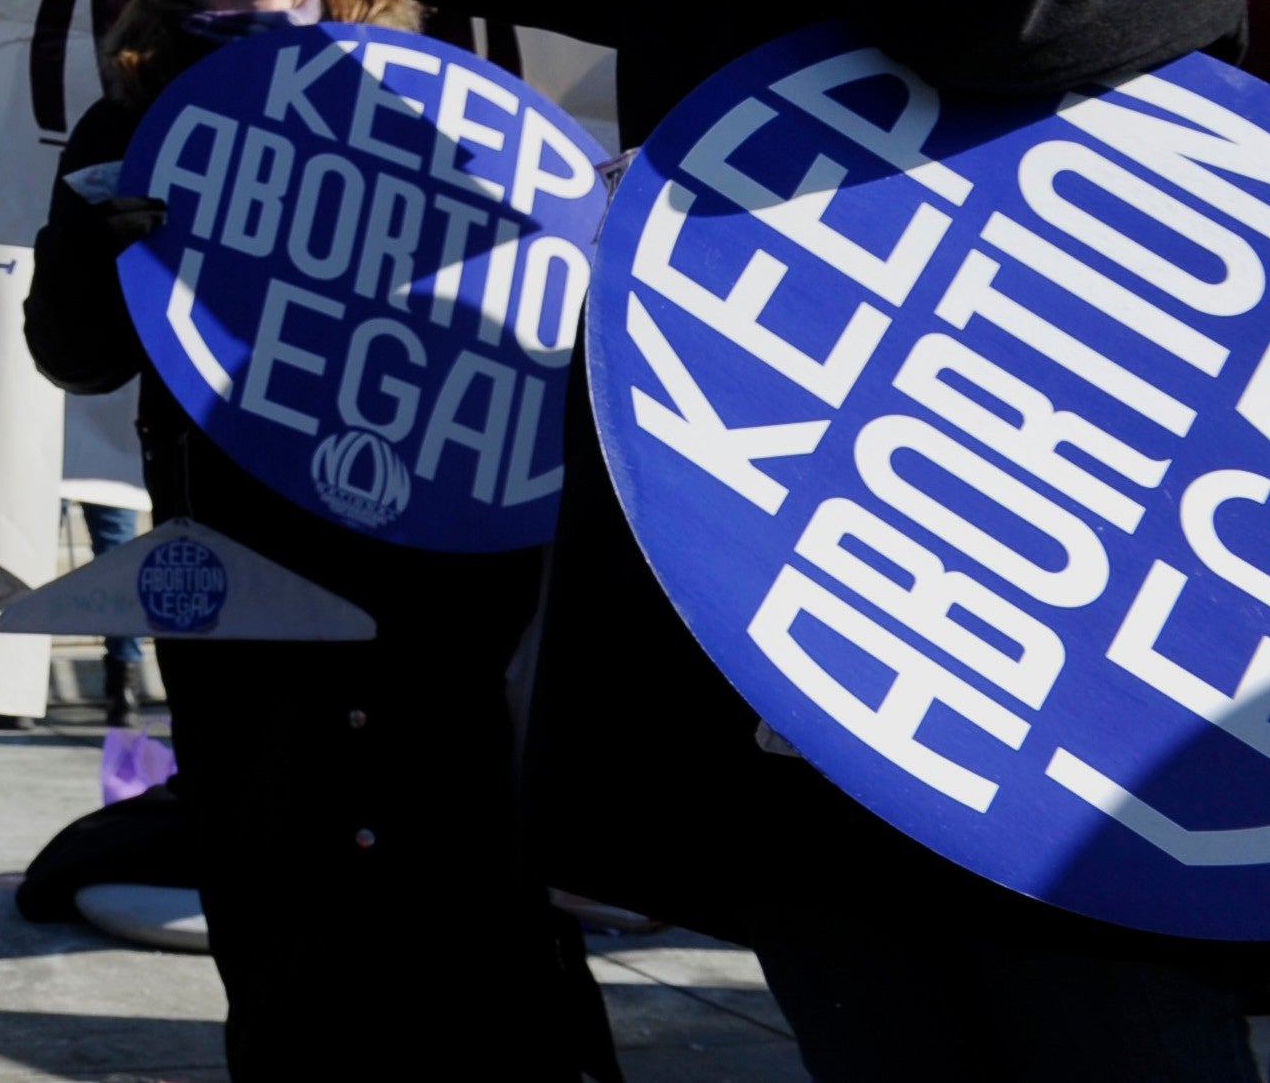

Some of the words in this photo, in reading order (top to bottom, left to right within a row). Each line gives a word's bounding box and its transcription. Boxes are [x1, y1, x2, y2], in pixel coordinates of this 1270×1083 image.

[264, 40, 596, 216] KEEP
[149, 104, 591, 368] ABORTIO
[626, 46, 975, 517] KEEP
[747, 73, 1270, 814] ABORTION
[140, 566, 224, 593] ABORTION
[148, 592, 217, 619] LEGAL
[154, 542, 211, 566] KEEP
